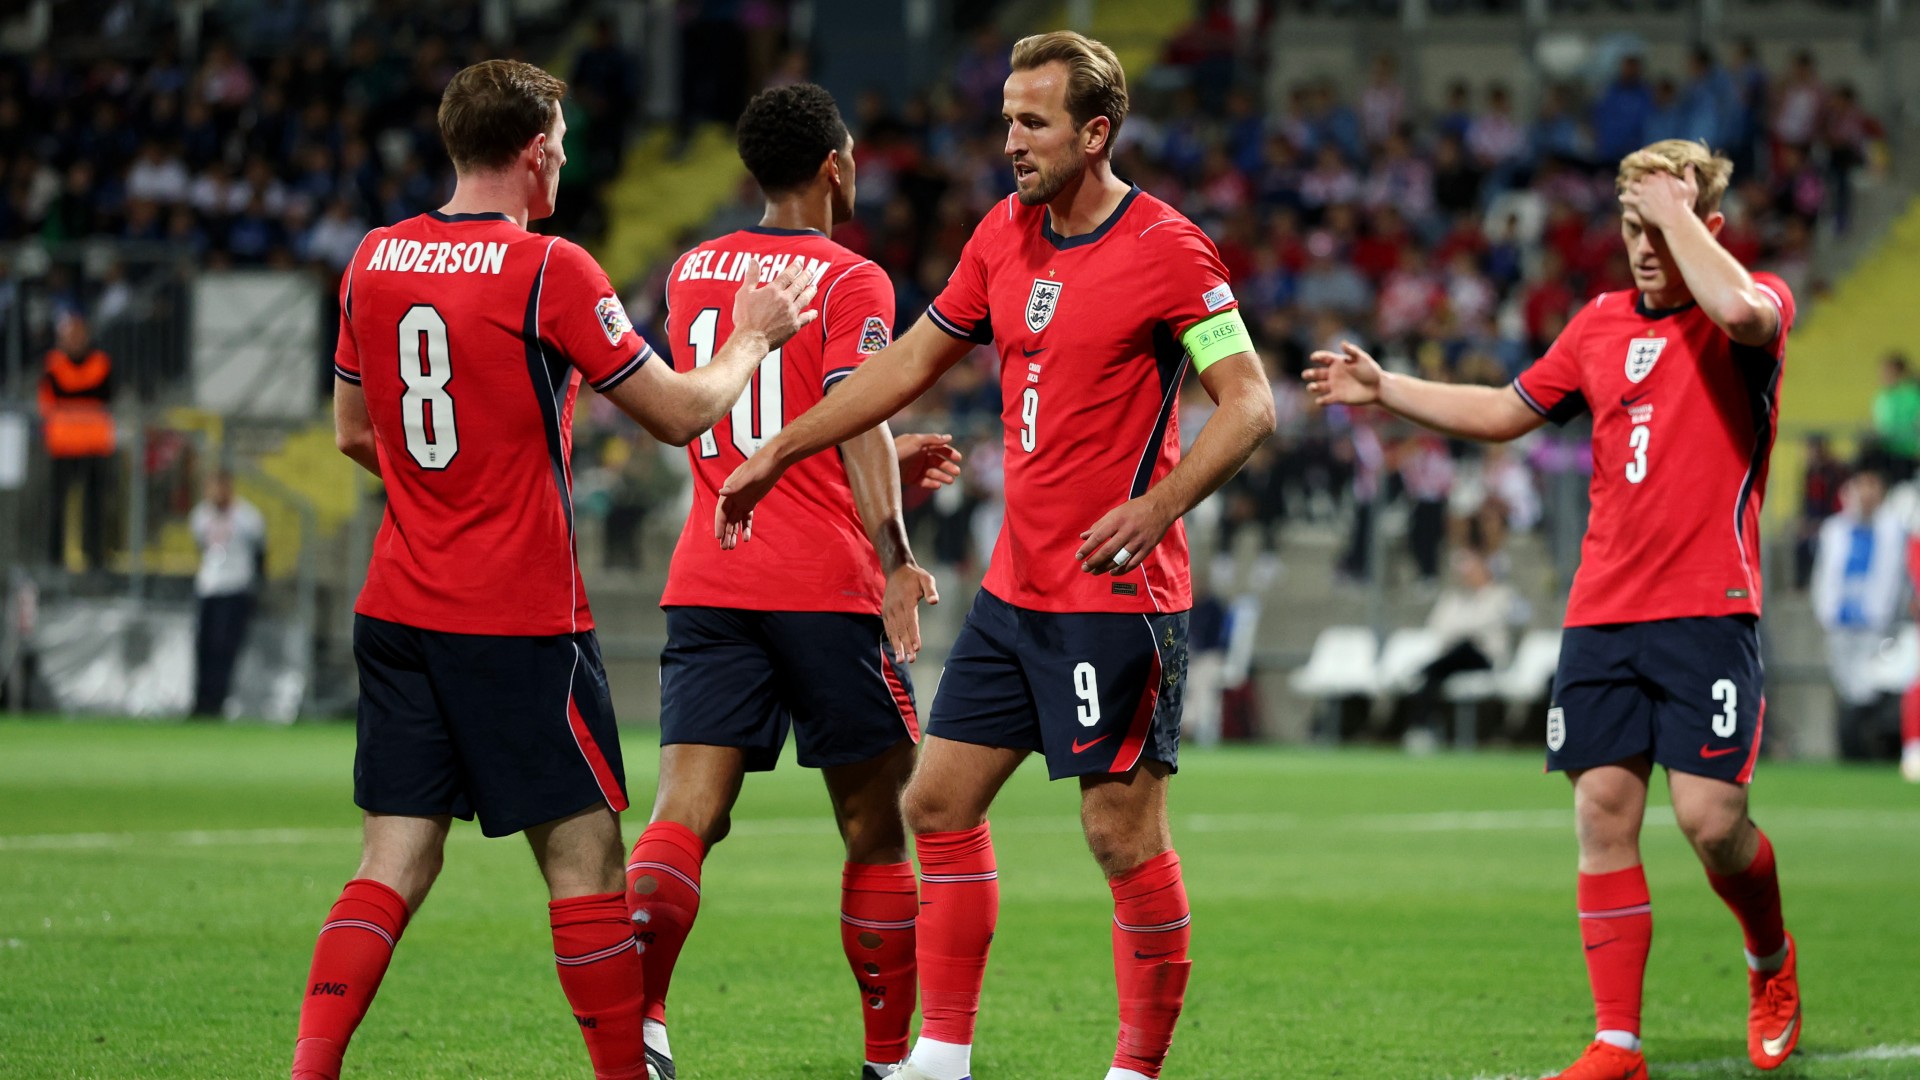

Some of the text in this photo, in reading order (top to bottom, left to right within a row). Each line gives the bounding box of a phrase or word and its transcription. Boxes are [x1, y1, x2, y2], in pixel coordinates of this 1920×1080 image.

[366, 238, 509, 275] ANDERSON
[397, 303, 460, 471] 8
[688, 307, 784, 461] 10
[1020, 386, 1040, 454] 9
[1625, 425, 1650, 484] 3
[1073, 662, 1101, 727] 9
[1711, 679, 1738, 738] 3
[311, 981, 348, 997] ENG
